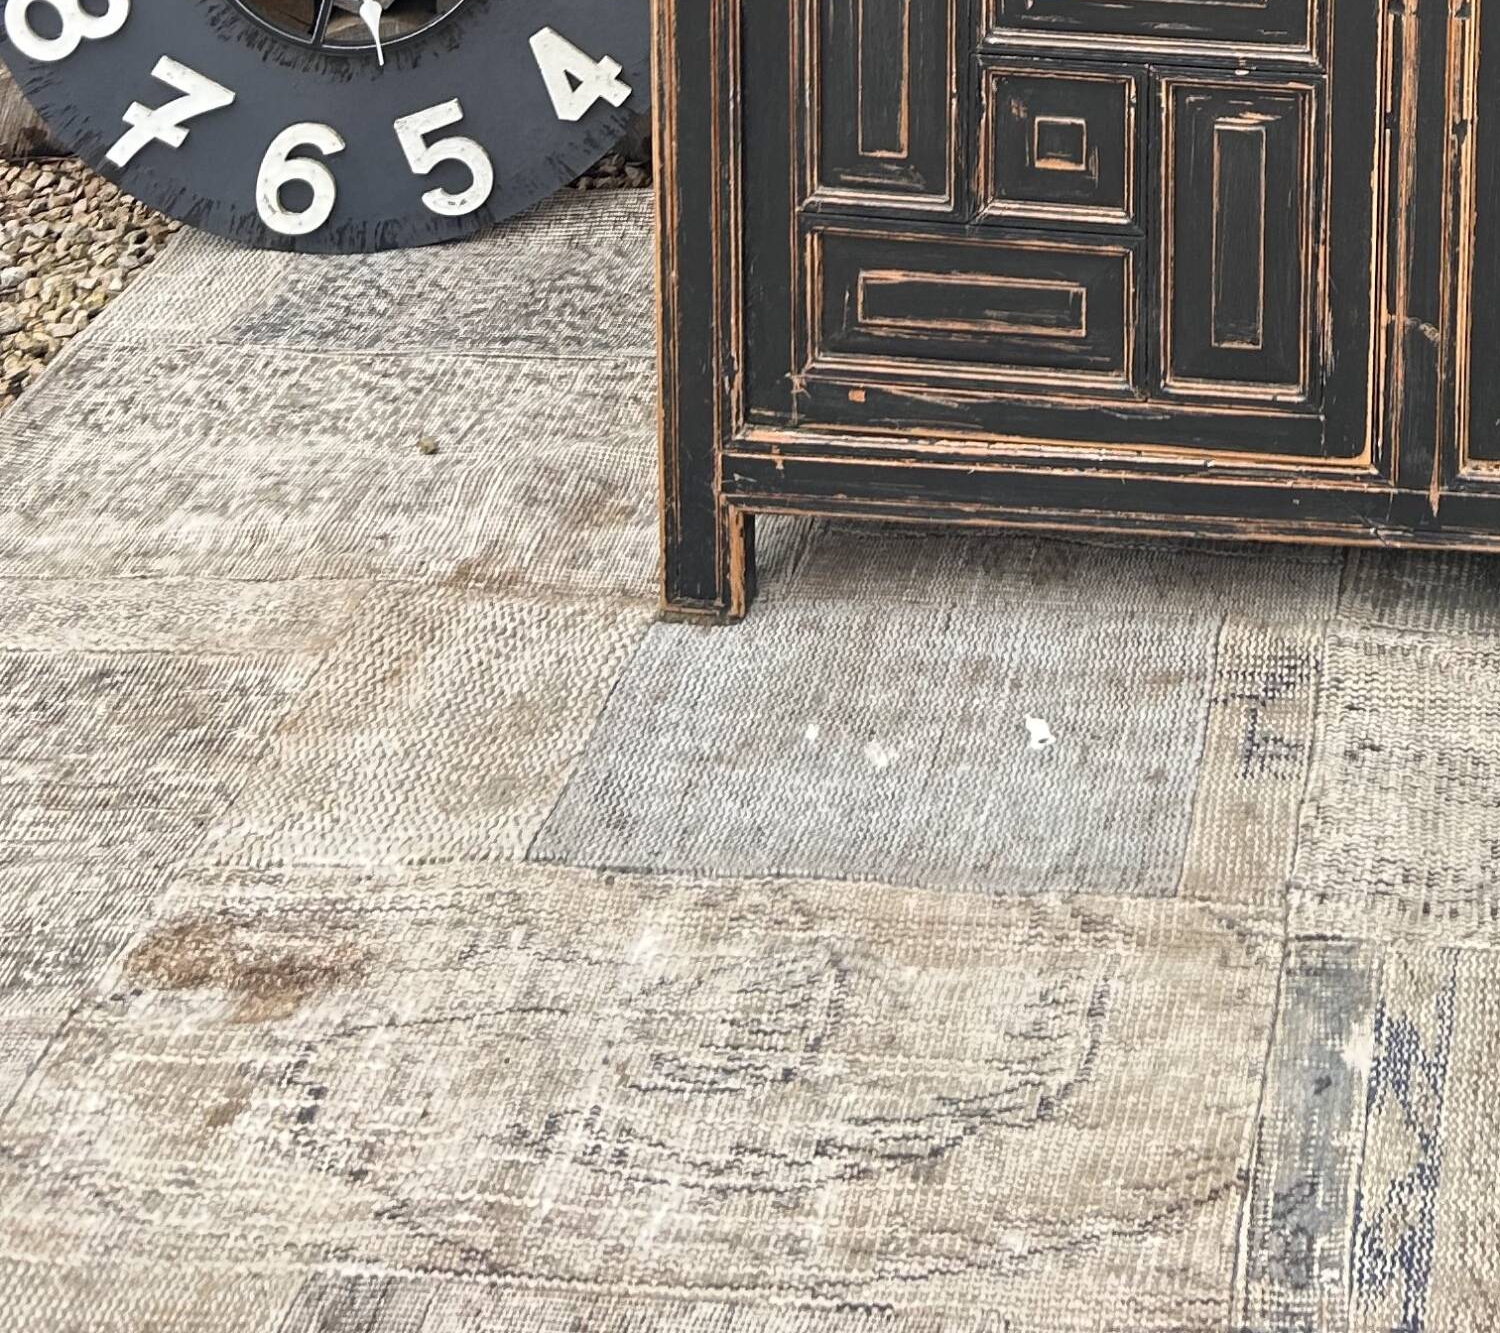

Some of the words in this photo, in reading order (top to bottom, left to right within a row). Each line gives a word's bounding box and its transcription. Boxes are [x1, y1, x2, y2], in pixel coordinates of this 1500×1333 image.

[105, 55, 236, 168] 7
[528, 26, 633, 121] 4
[255, 122, 347, 235] 6
[394, 98, 494, 217] 5
